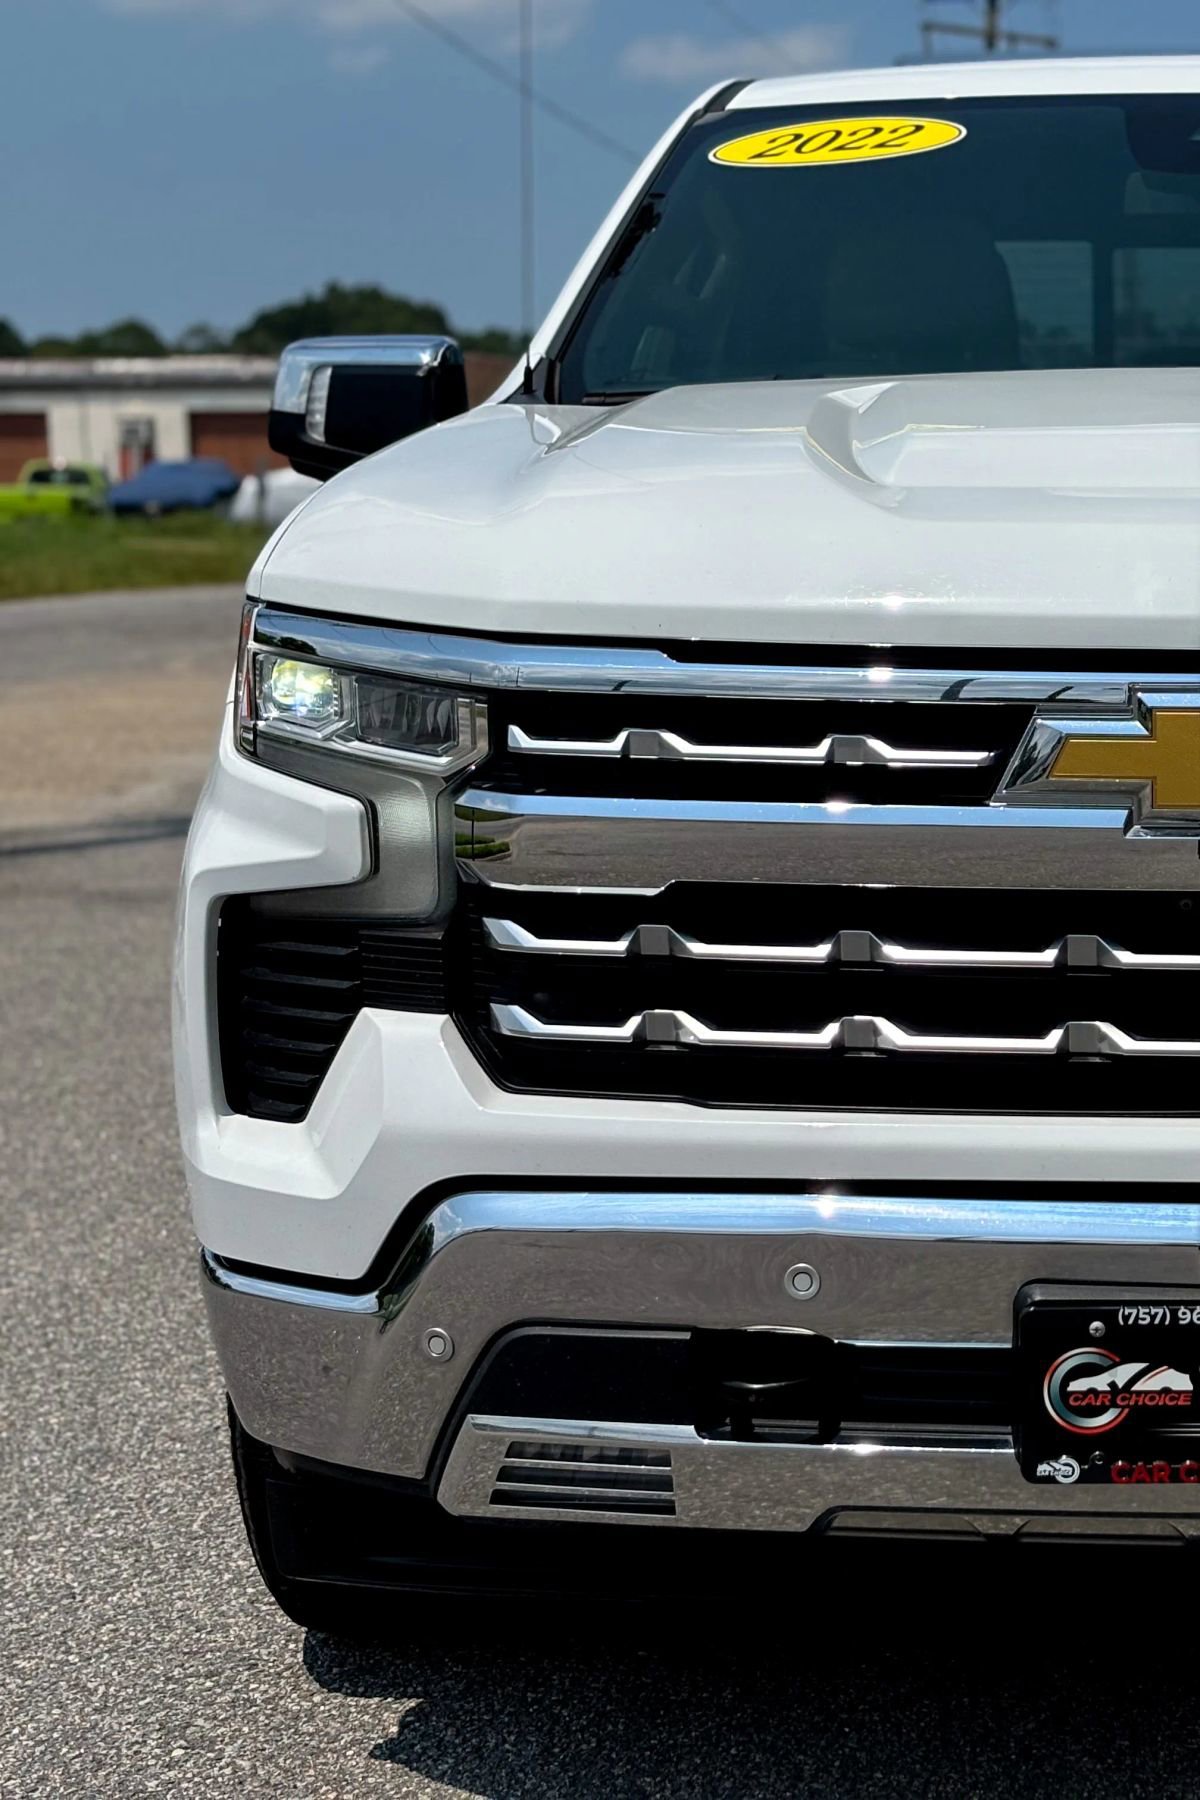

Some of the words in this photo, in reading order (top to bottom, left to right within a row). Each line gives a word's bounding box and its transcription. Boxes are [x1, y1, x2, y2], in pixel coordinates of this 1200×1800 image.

[748, 124, 924, 160] 2022
[1118, 1305, 1170, 1325] (757)
[1069, 1393, 1112, 1406] CAR
[1116, 1393, 1192, 1406] CHOICE
[1110, 1461, 1171, 1483] CAR
